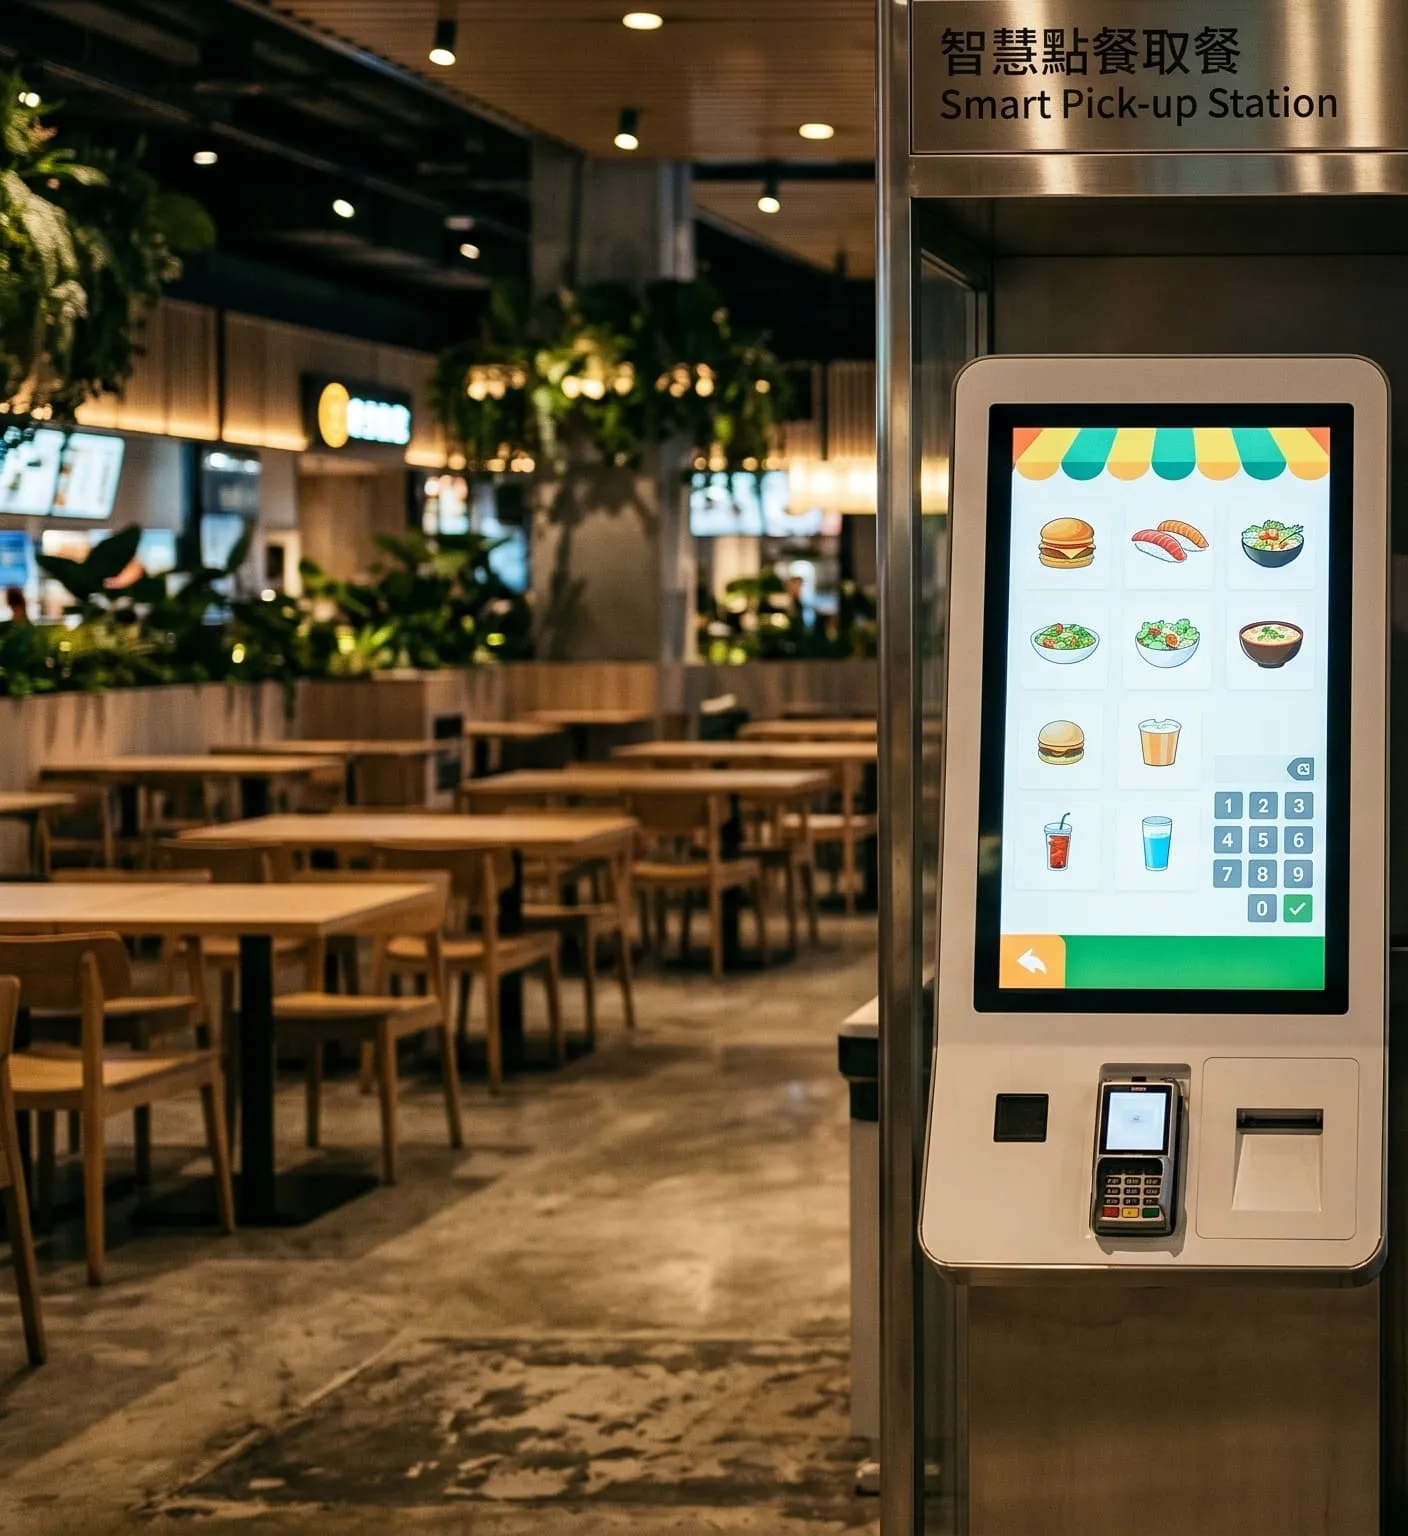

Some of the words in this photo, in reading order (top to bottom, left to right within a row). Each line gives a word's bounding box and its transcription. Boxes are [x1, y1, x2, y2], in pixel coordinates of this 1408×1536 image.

[940, 27, 1242, 77] 智慧點餐取餐
[940, 88, 1052, 120] Smart
[1062, 87, 1198, 126] Pick-up
[1208, 86, 1338, 119] Station
[1224, 798, 1232, 813] 1
[1258, 798, 1269, 813] 2
[1293, 798, 1305, 813] 3
[1221, 832, 1233, 848] 4
[1258, 832, 1269, 848] 5
[1293, 832, 1304, 848] 6
[1221, 866, 1233, 882] 7
[1257, 866, 1268, 882] 8
[1292, 866, 1304, 882] 9
[1256, 900, 1268, 916] 0
